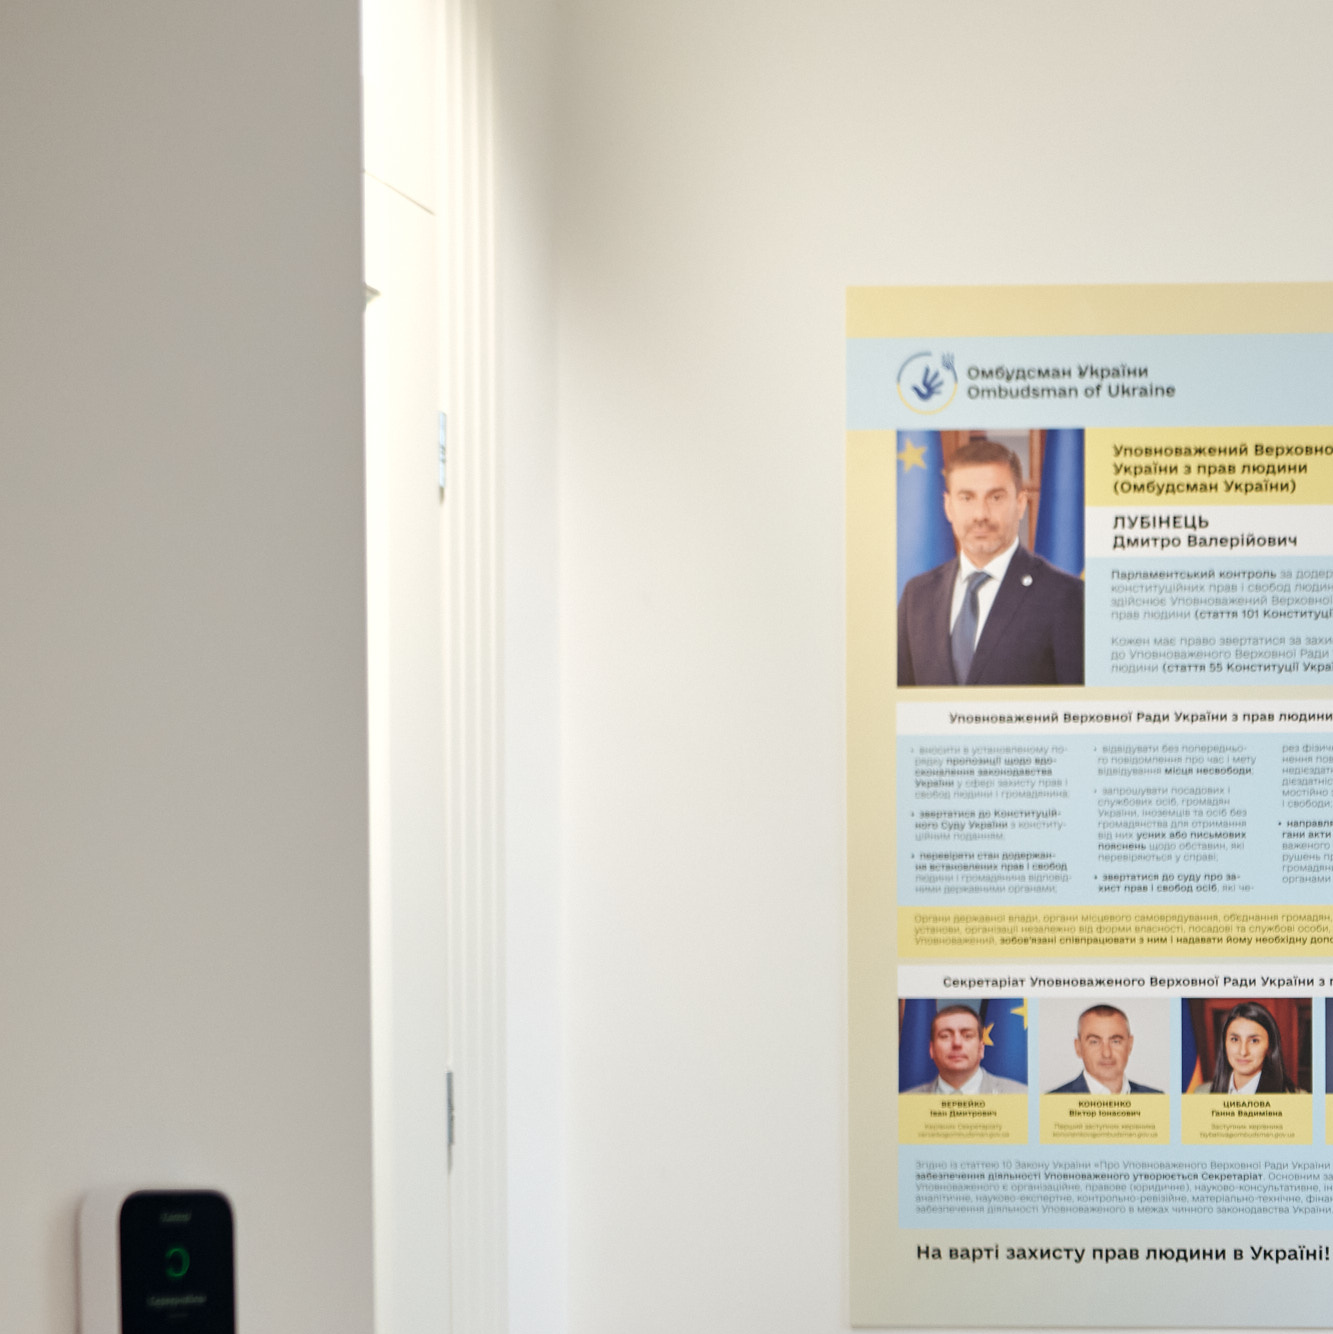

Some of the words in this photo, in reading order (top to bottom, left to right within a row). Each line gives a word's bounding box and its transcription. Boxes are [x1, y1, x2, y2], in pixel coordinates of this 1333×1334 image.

[967, 365, 1072, 382] Омбудсман
[1077, 364, 1148, 380] України
[966, 384, 1078, 399] Ombudsman
[1083, 383, 1102, 397] of
[1107, 383, 1175, 397] Ukraine
[1113, 443, 1248, 457] Уповноважений
[1113, 463, 1178, 476] України
[1183, 464, 1192, 474] з
[1196, 464, 1236, 476] прав
[1241, 464, 1308, 475] людини
[1113, 480, 1218, 495] (Омбудсман
[1223, 479, 1296, 494] України)
[1113, 515, 1209, 530] ЛУБІНЕЦЬ
[1112, 535, 1181, 549] Дмитро
[1187, 533, 1297, 549] Валерійович
[949, 712, 1058, 723] Уповноважений
[1062, 712, 1132, 724] Верховної
[1136, 711, 1170, 723] Ради
[1173, 711, 1228, 723] України
[1231, 713, 1238, 721] з
[1242, 712, 1275, 723] прав
[1278, 712, 1333, 722] людини
[942, 976, 1025, 989] Секретаріат
[1029, 976, 1145, 987] Уповноваженого
[1149, 976, 1218, 988] Верховної
[1222, 976, 1256, 988] Ради
[1260, 975, 1314, 988] України
[1318, 978, 1325, 986] з
[916, 1245, 942, 1259] На
[948, 1244, 999, 1262] варті
[1005, 1247, 1085, 1263] захисту
[1091, 1248, 1139, 1263] прав
[1145, 1247, 1226, 1262] людини
[1232, 1248, 1244, 1260] в
[1249, 1244, 1330, 1264] Україні!
